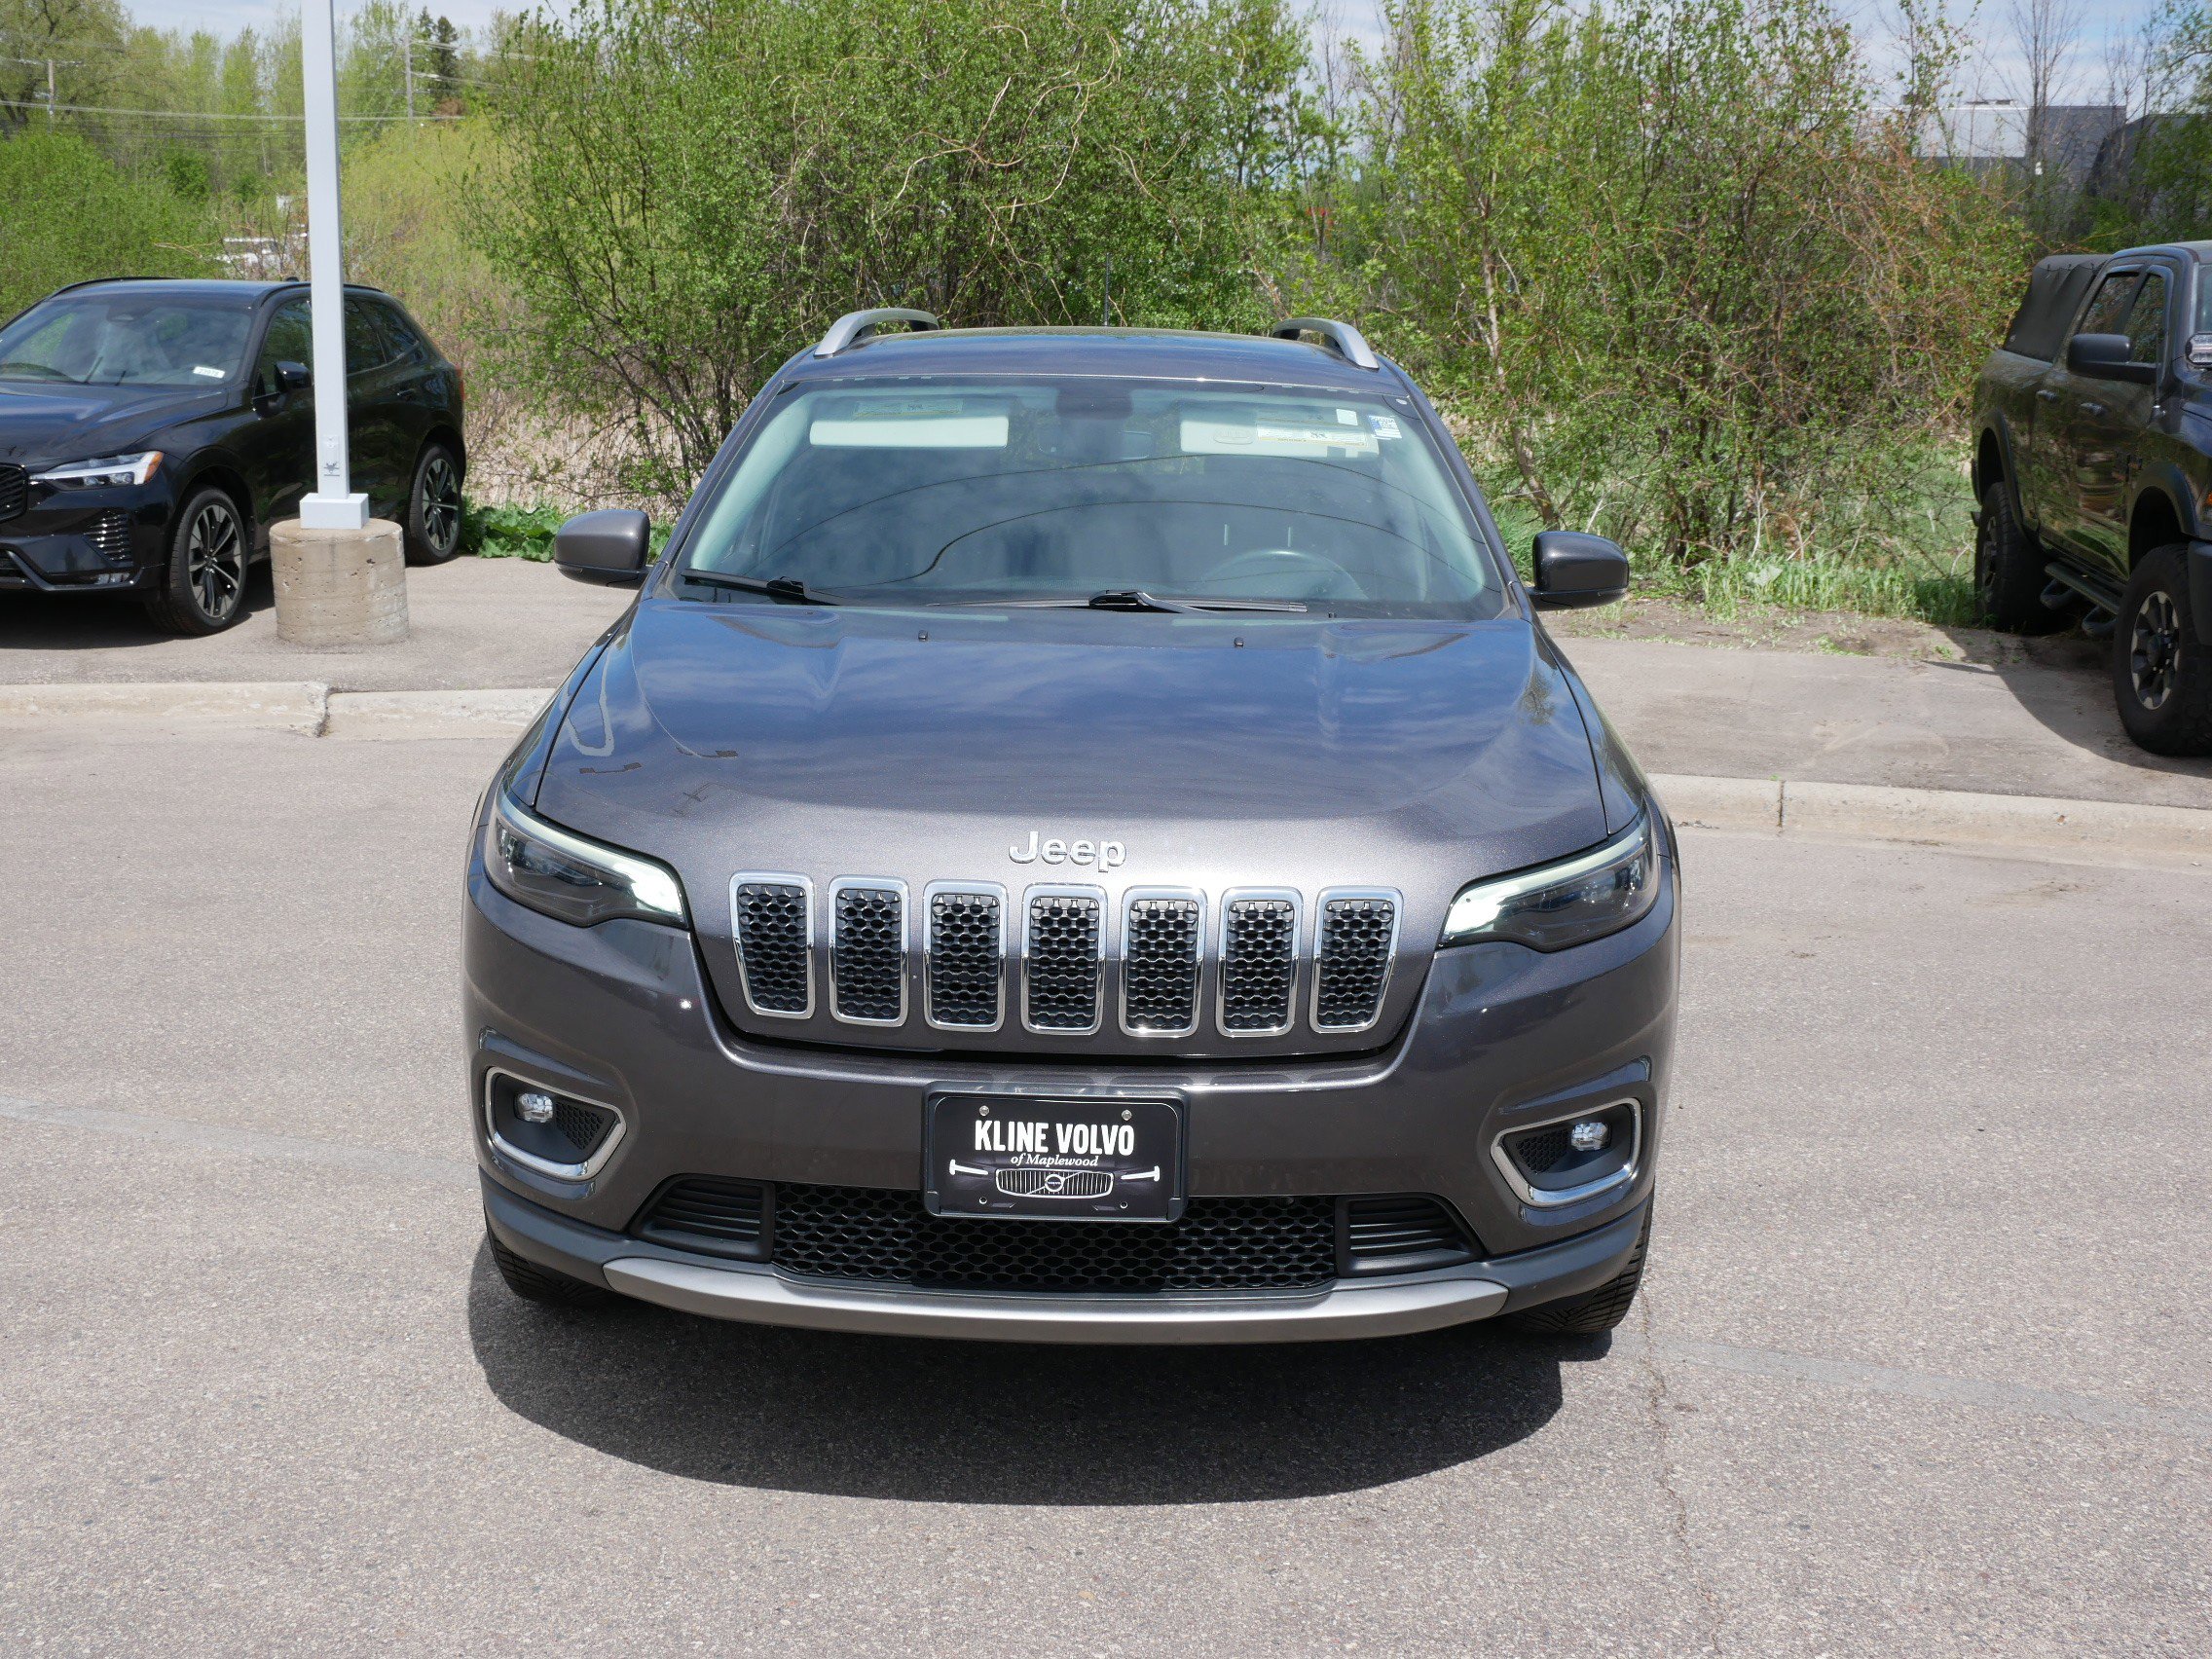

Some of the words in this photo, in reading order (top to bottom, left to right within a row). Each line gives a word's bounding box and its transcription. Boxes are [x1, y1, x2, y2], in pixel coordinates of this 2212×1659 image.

[1009, 830, 1126, 872] Jeep
[975, 1120, 1050, 1153] KLINE
[1055, 1123, 1135, 1156] VOLVO
[1011, 1153, 1026, 1166] of
[1026, 1154, 1099, 1167] Maplewood
